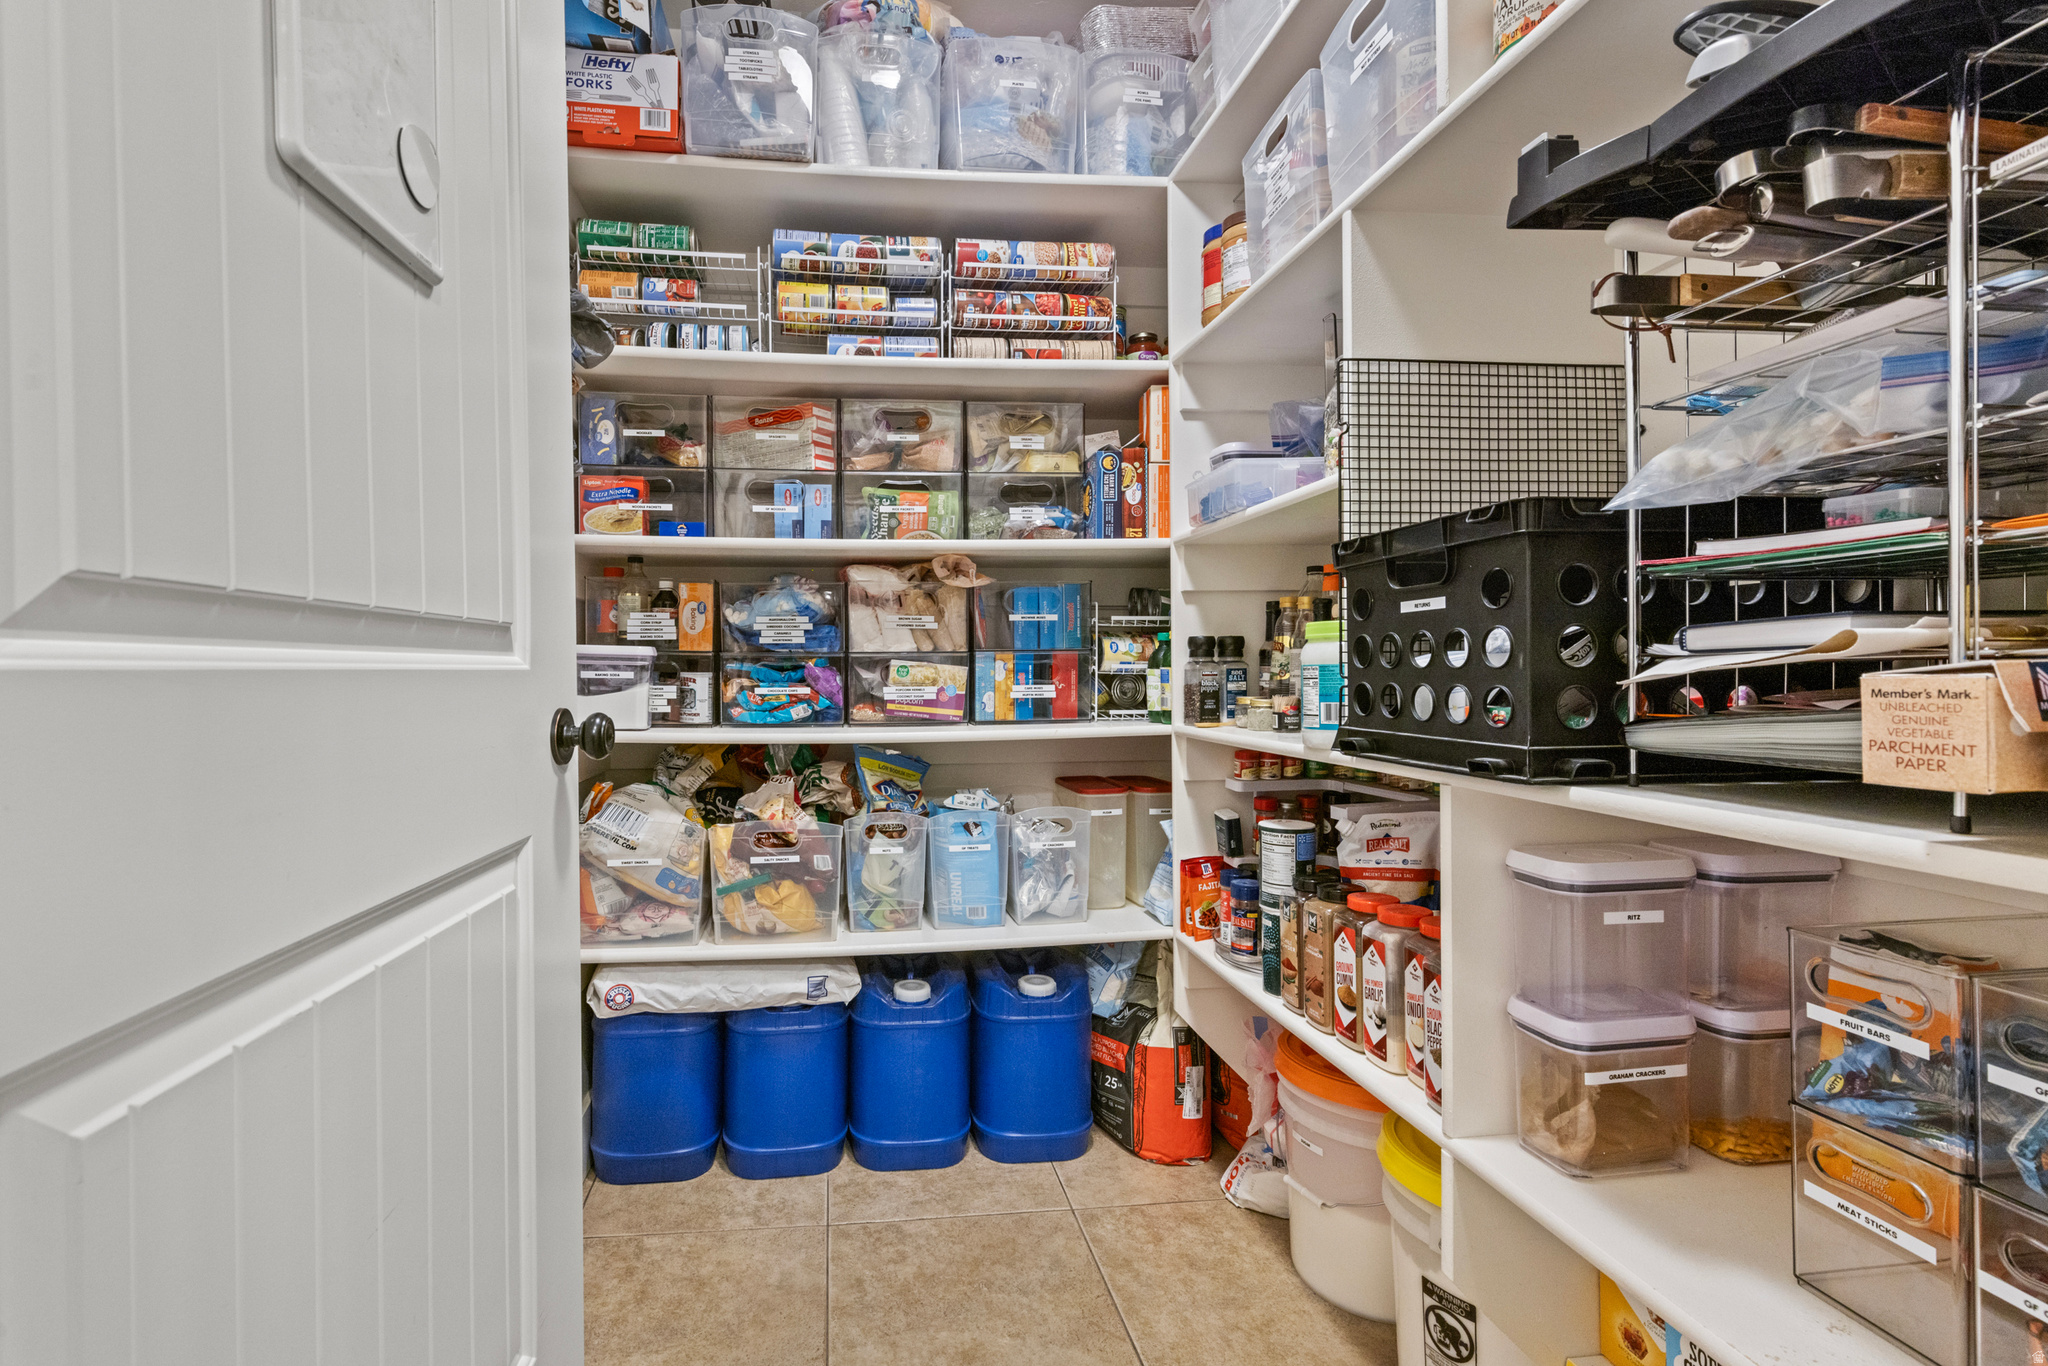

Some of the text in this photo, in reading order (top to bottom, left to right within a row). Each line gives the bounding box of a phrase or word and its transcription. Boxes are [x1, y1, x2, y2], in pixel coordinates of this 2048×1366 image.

[585, 56, 632, 72] Hefty
[566, 77, 612, 90] FORKS
[754, 416, 773, 425] Banza
[1130, 528, 1142, 537] 12
[1871, 688, 1971, 700] Member's Mark
[1879, 702, 1962, 713] UNBLEACHED
[1892, 715, 1949, 726] GENUINE
[1887, 728, 1954, 740] VEGETABLE
[1869, 739, 1977, 757] PARCHMENT
[1896, 756, 1947, 772] PAPER
[1370, 822, 1401, 830] Redmond
[1368, 838, 1408, 850] REAL SALT
[1198, 881, 1220, 891] FAJITA
[950, 871, 962, 916] UNREAL
[1240, 919, 1254, 929] SALT
[1336, 961, 1353, 974] GROUND
[1336, 972, 1354, 987] CUMIN
[1371, 980, 1383, 988] POWDER
[607, 987, 631, 1001] CRYSTAL
[1364, 986, 1383, 1002] GARLIC
[609, 1000, 630, 1010] SUGAR
[1427, 1020, 1442, 1036] BLAC
[1840, 1018, 1891, 1042] FRUIT BARS
[1609, 1069, 1666, 1080] GRAHAM CRACKERS
[1105, 1075, 1118, 1089] 25
[1852, 1165, 1870, 1176] WITH
[1837, 1202, 1898, 1239] MEAT STICKS
[1433, 1285, 1470, 1311] WARNING
[1442, 1299, 1466, 1317] AVISO
[2024, 1300, 2038, 1310] GF
